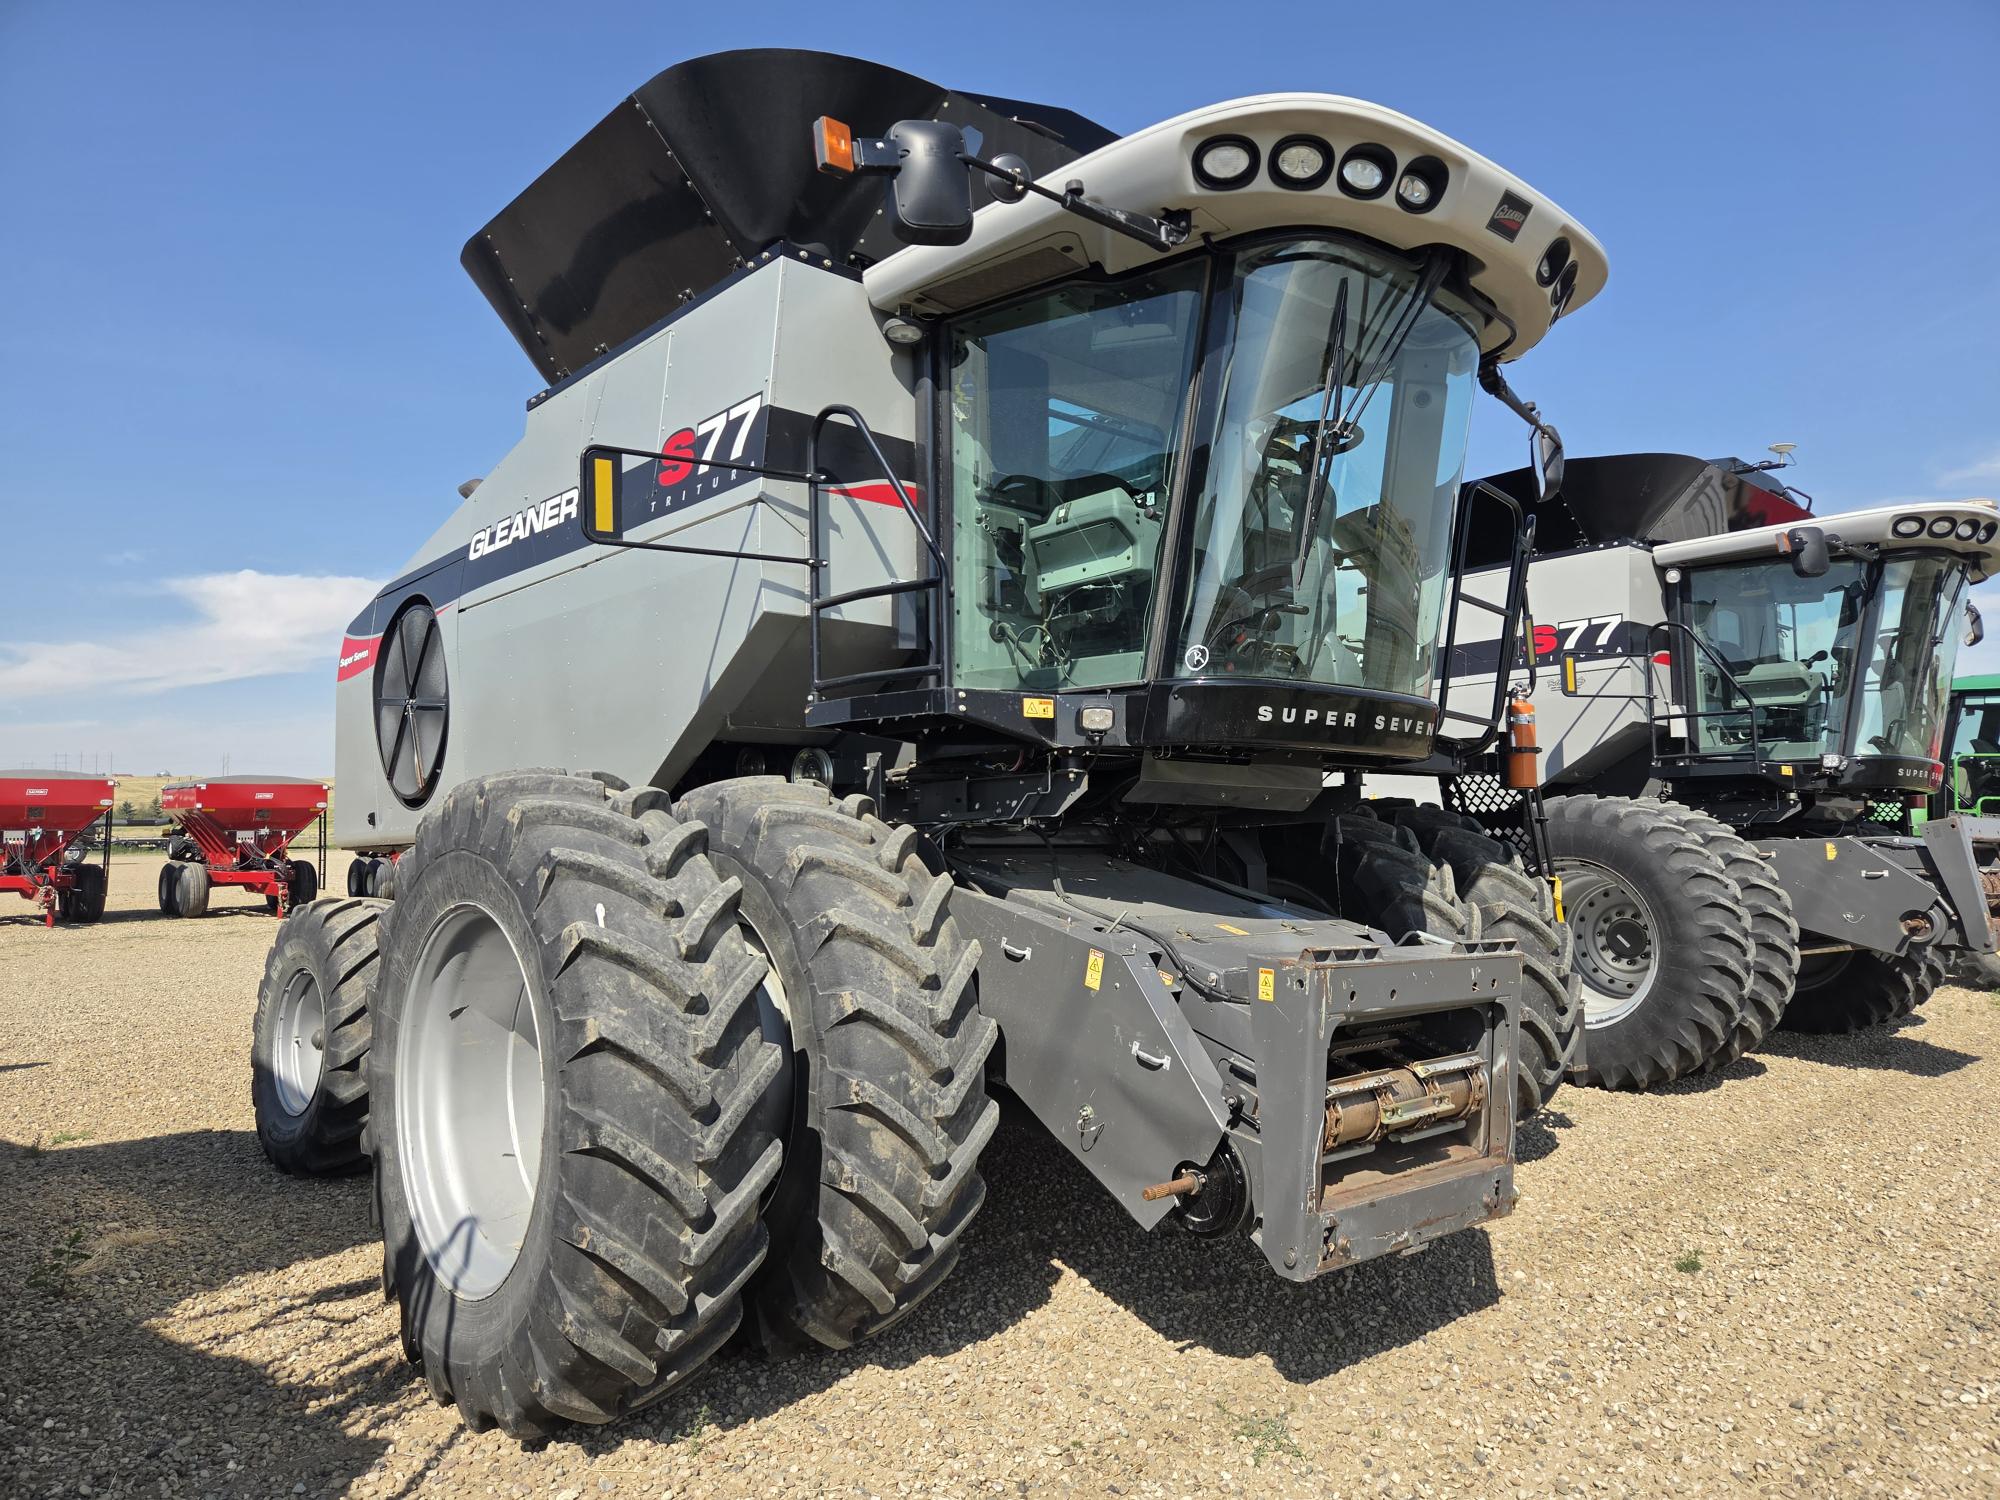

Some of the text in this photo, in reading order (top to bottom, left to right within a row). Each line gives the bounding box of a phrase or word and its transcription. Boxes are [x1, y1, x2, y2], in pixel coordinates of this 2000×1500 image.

[657, 391, 763, 488] S77
[468, 486, 580, 561] GLEANER
[1522, 613, 1622, 655] S77
[1257, 705, 1436, 737] SUPER SEVEN
[1897, 768, 1929, 779] SUPER
